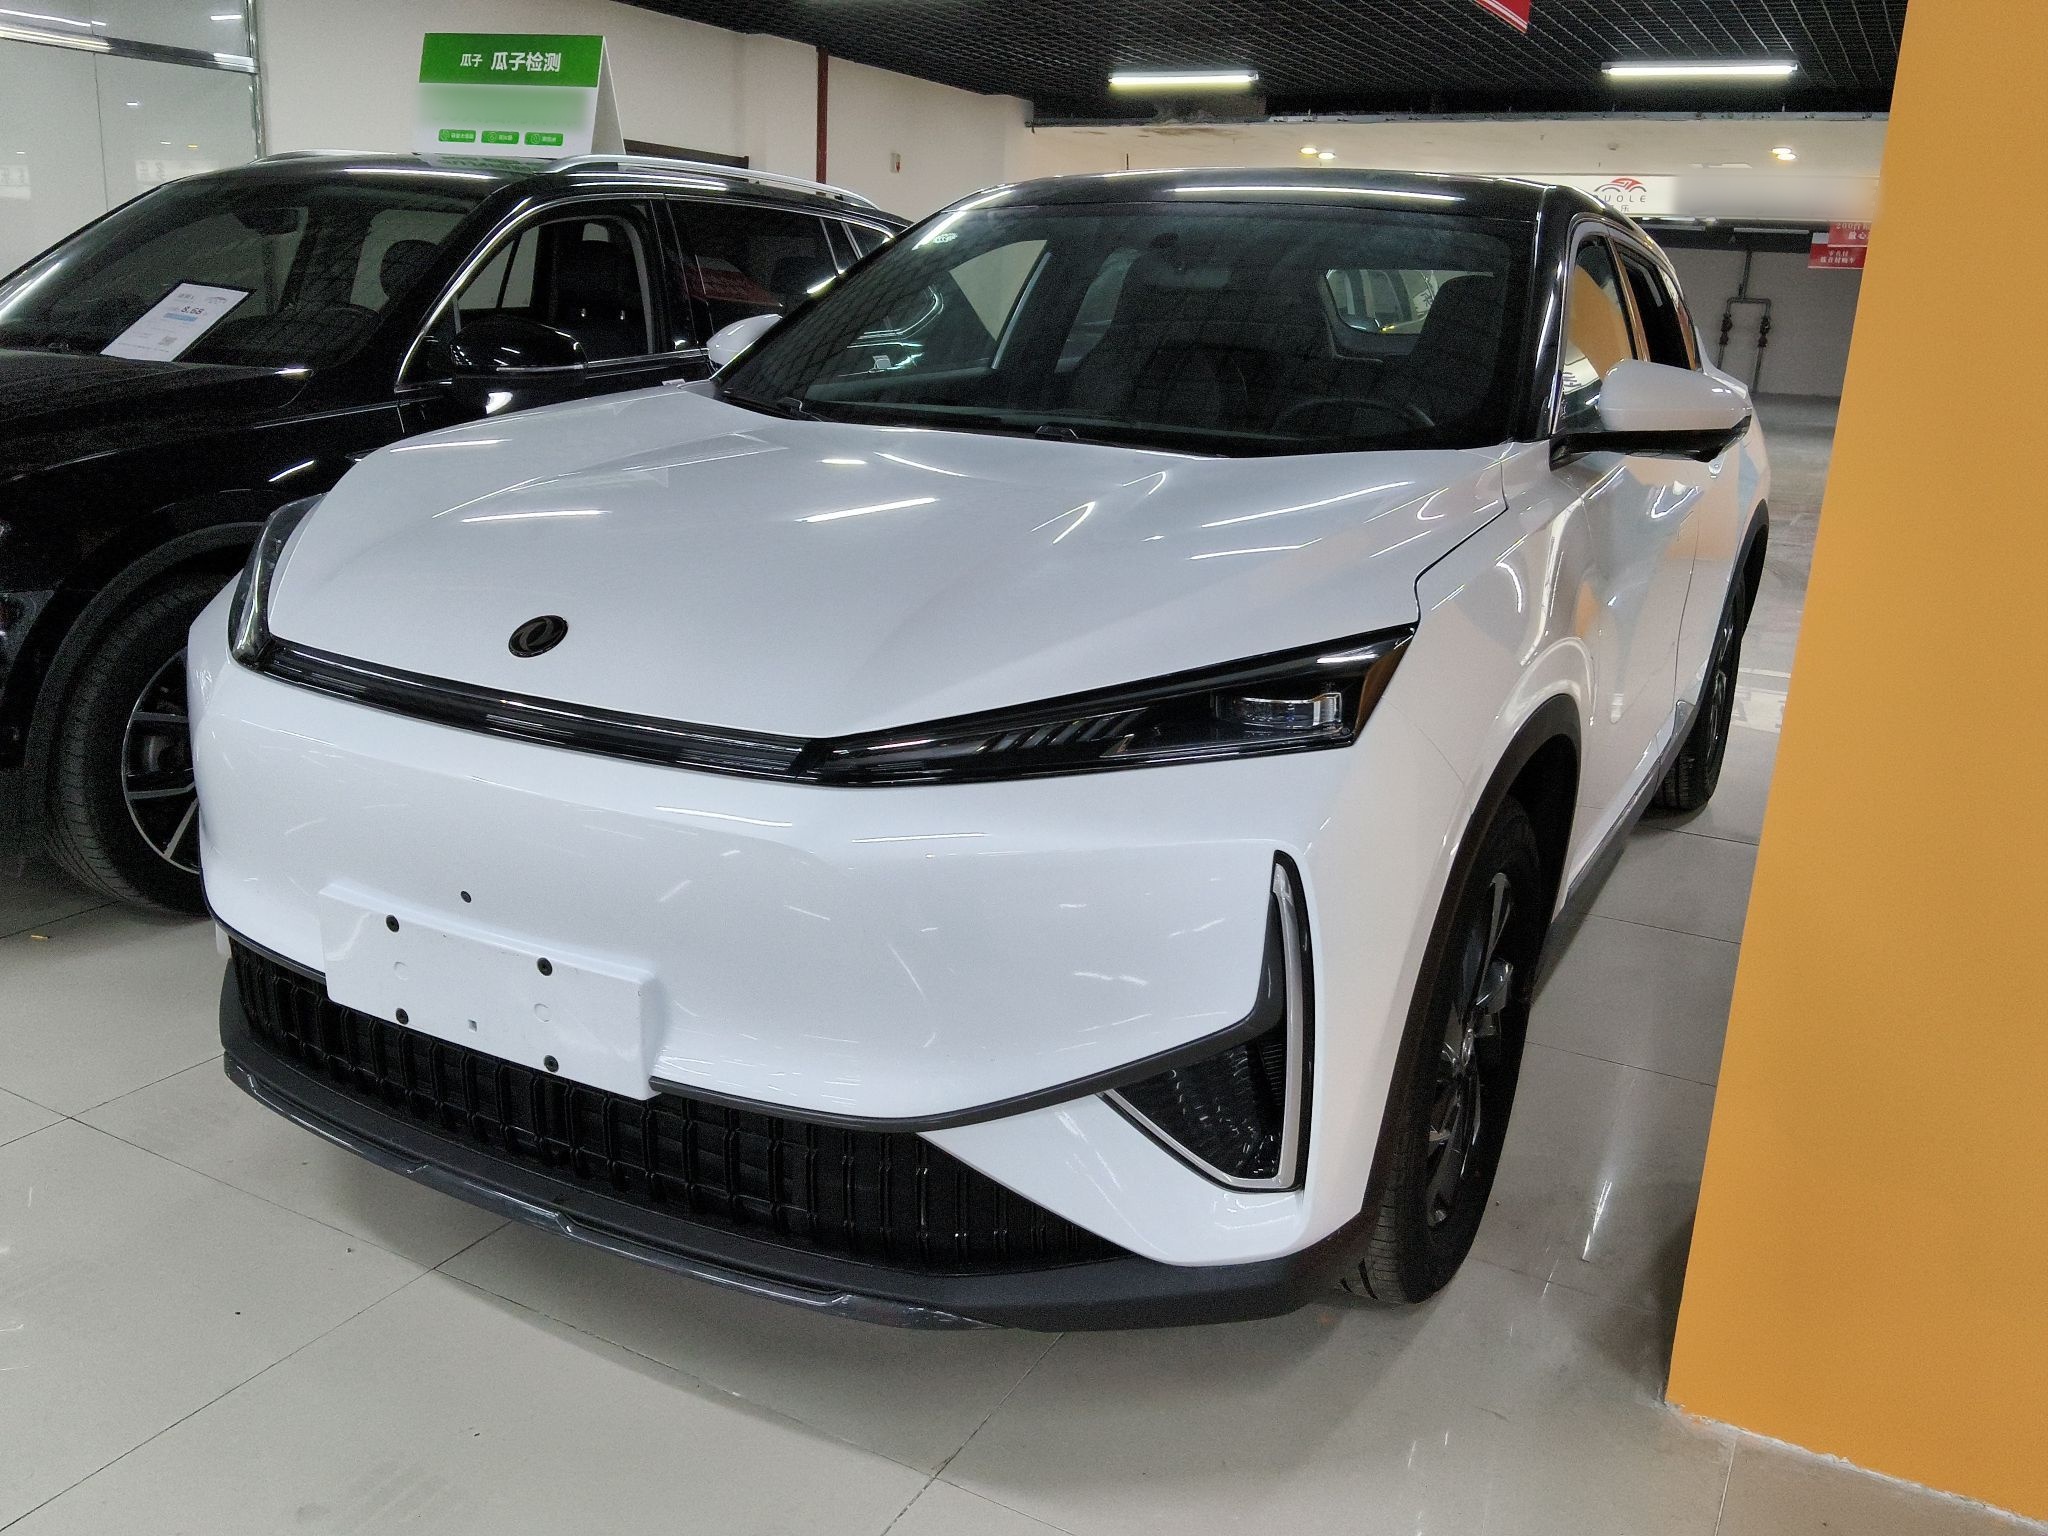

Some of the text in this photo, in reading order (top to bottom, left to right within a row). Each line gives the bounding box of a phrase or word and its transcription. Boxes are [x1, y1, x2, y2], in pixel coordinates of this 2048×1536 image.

[460, 51, 562, 72] 瓜子 瓜子检测
[1595, 194, 1647, 203] UOLE
